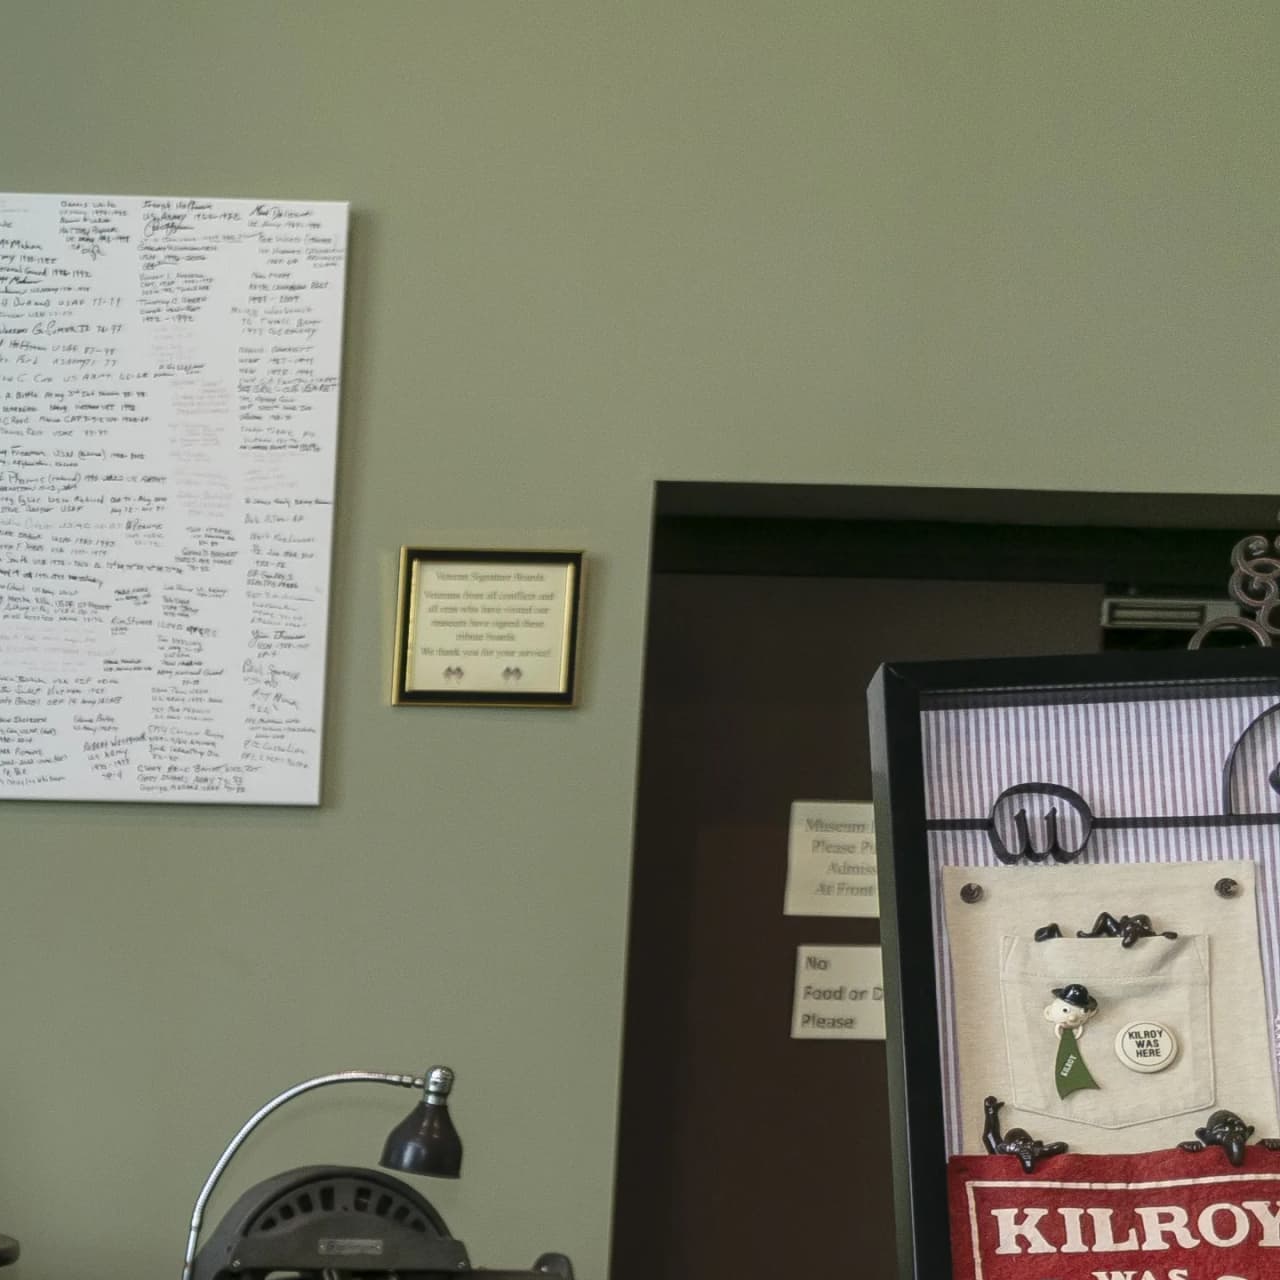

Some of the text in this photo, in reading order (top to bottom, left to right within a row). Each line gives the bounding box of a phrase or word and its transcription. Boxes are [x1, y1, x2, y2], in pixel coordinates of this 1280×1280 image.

[801, 1014, 855, 1029] Please
[1128, 1030, 1163, 1040] KILROY
[1135, 1039, 1159, 1048] WAS
[1136, 1048, 1161, 1058] HERE
[990, 1199, 1280, 1256] KILROY
